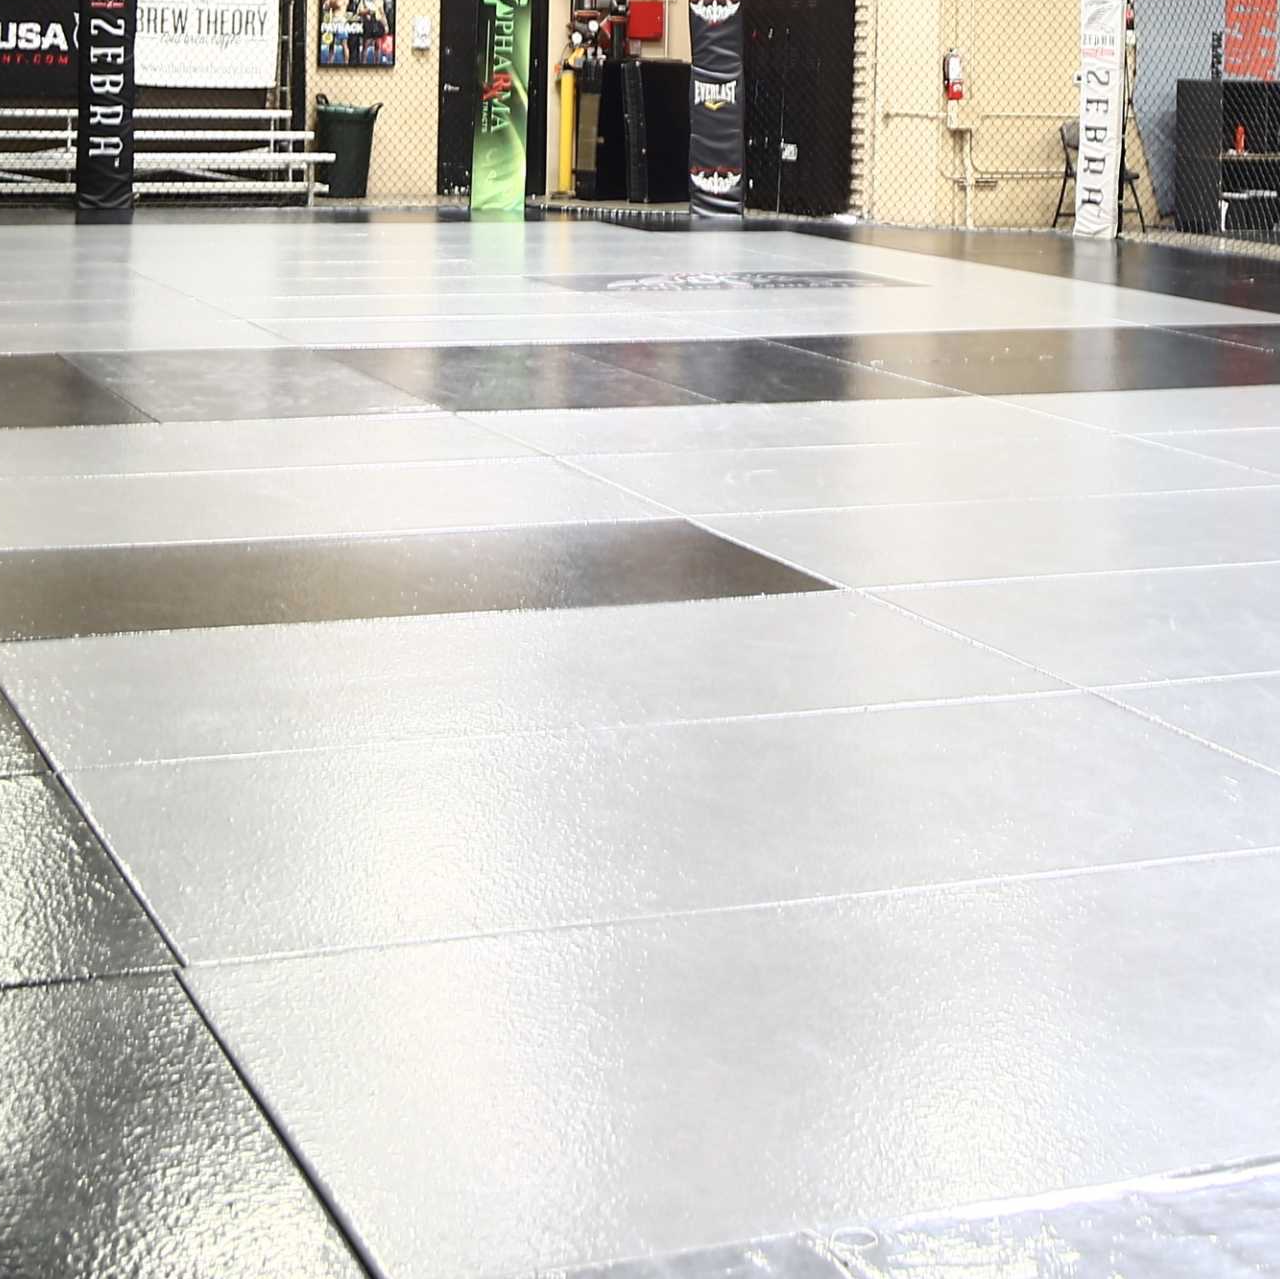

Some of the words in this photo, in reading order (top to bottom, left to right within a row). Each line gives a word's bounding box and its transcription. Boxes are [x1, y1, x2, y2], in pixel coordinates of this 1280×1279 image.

[136, 6, 188, 34] BREW
[195, 7, 268, 37] THEORY
[88, 18, 126, 157] ZEBRA
[694, 80, 737, 105] EVERLAST
[1080, 70, 1111, 206] ZEBRA
